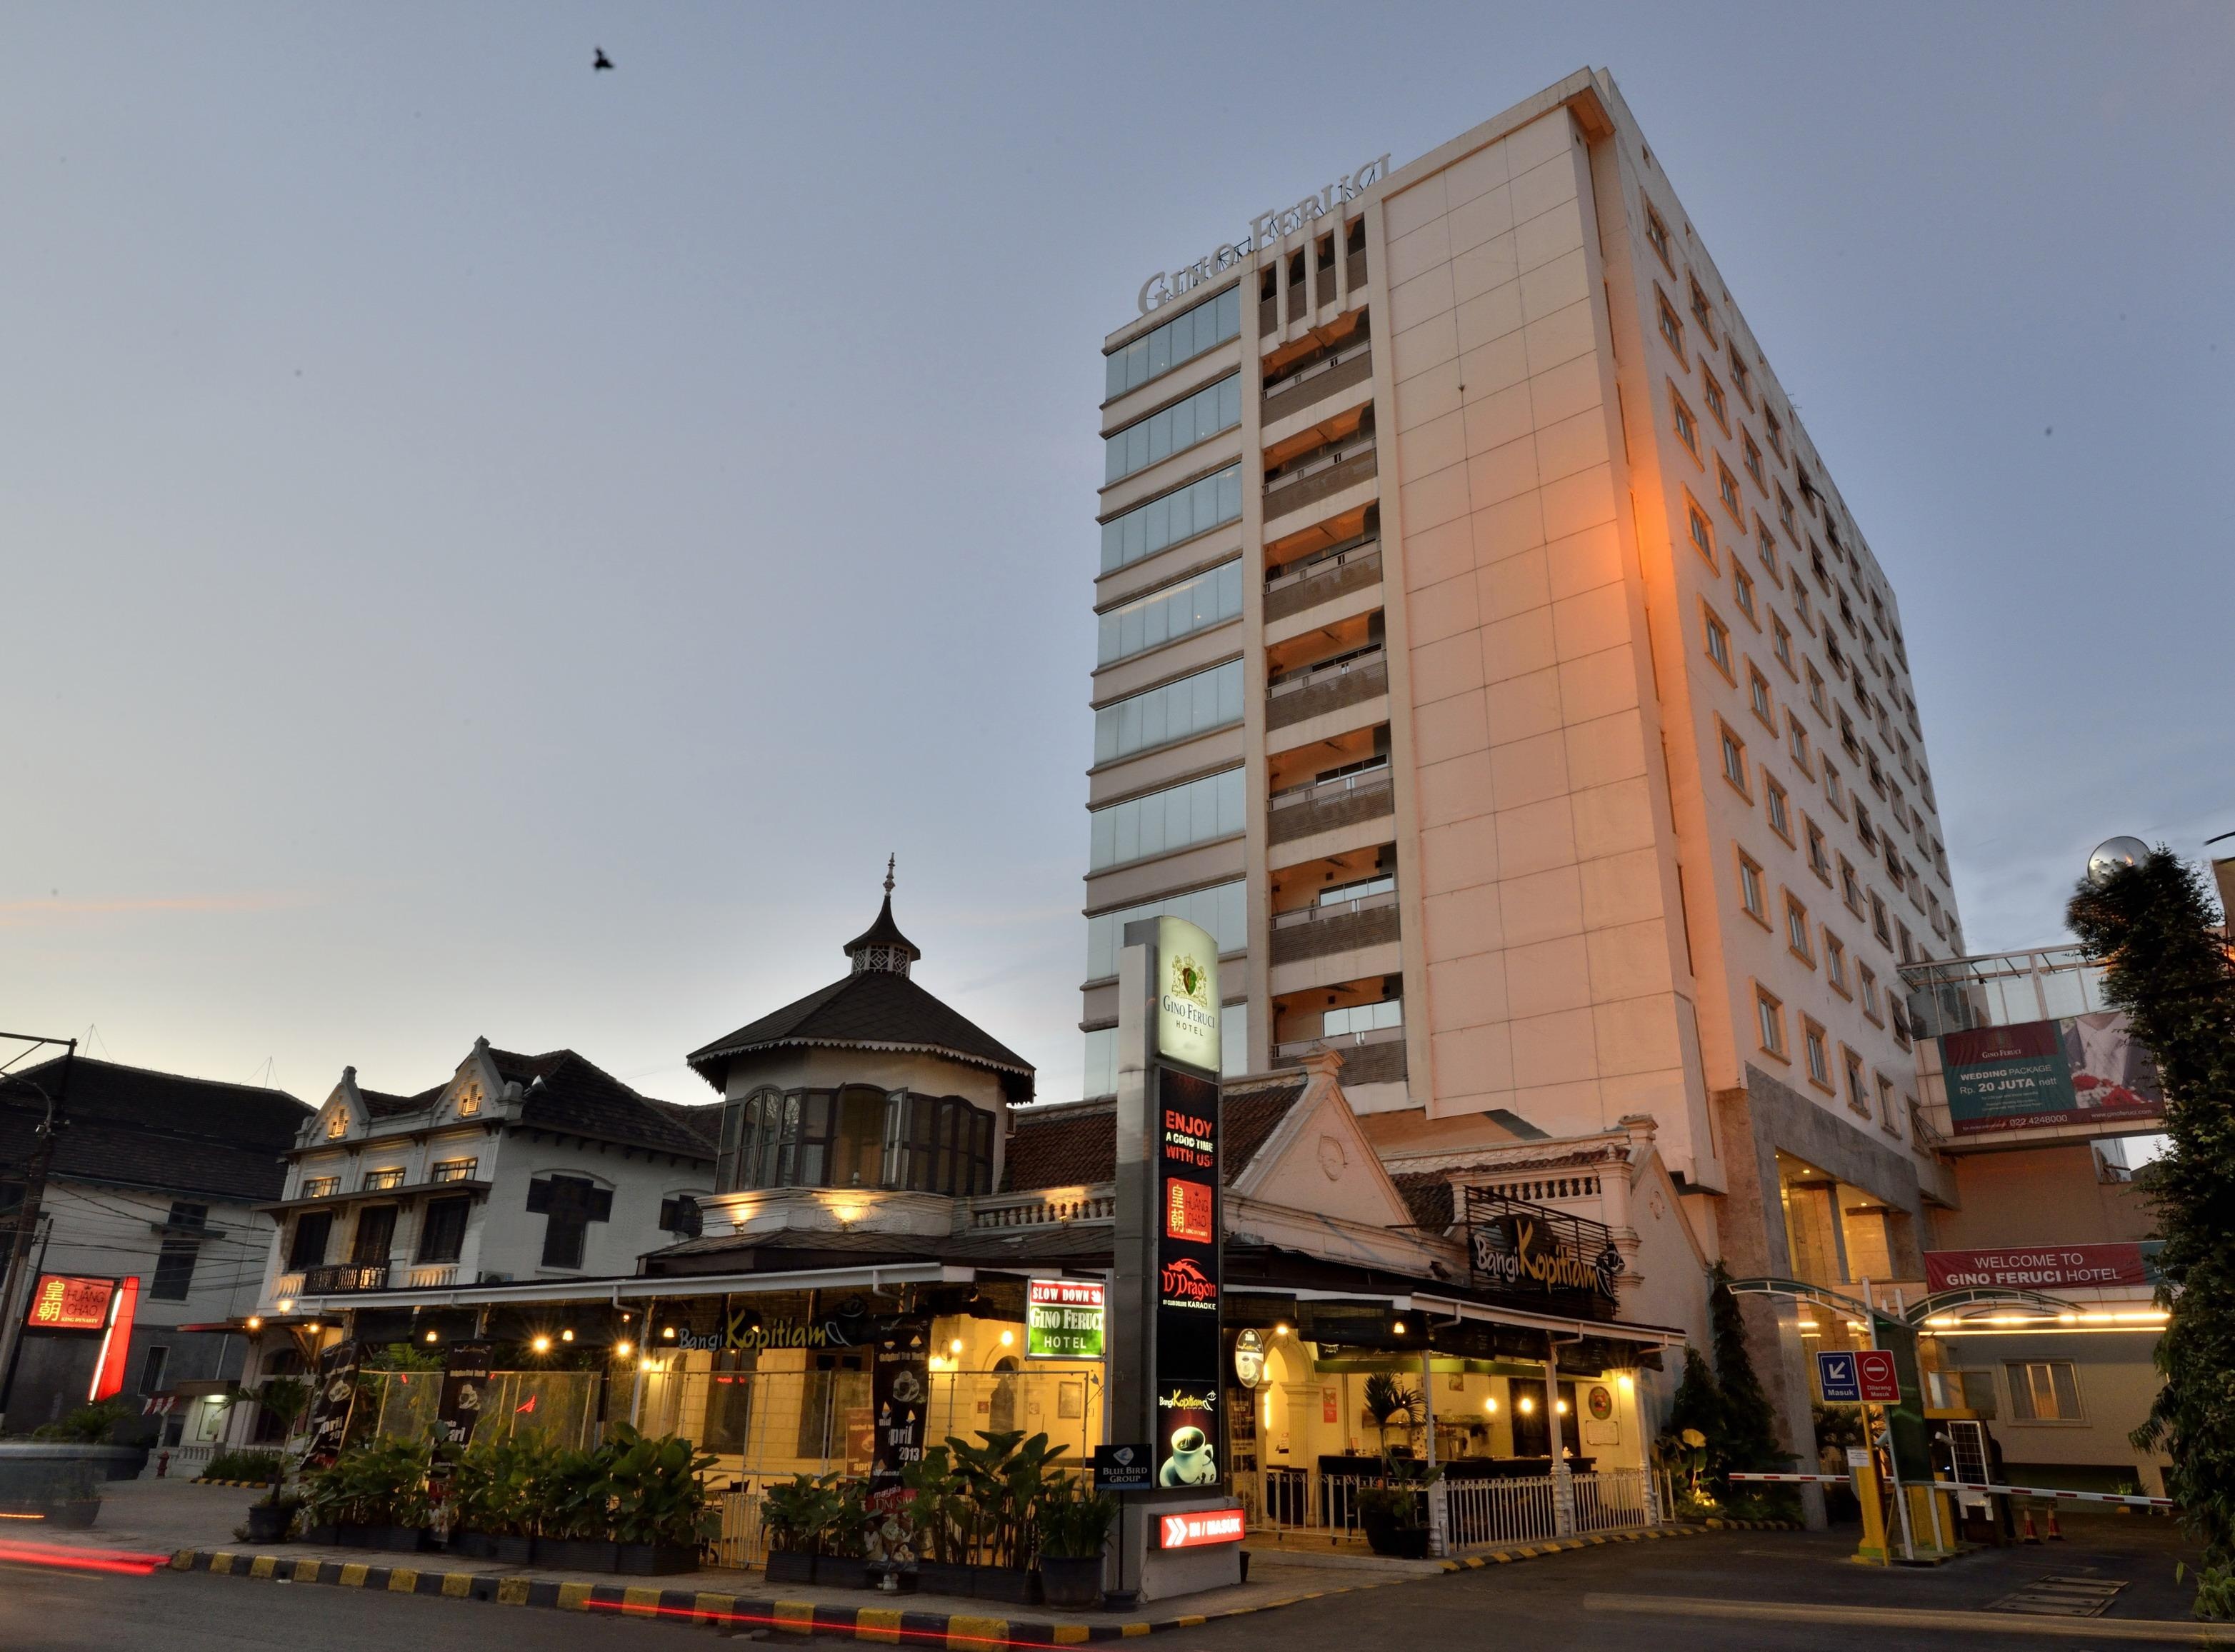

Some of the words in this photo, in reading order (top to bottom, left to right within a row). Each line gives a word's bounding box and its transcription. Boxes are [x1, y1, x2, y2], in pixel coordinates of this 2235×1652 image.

[1138, 243, 1236, 316] GINO
[1249, 152, 1391, 251] FERUCI
[1163, 995, 1186, 1017] GINO
[1188, 1003, 1215, 1029] FERUCI
[1176, 1021, 1204, 1036] HOTEL
[1999, 1048, 2021, 1057] FERUCI
[1960, 1069, 2007, 1081] WEDDING
[2009, 1064, 2052, 1075] PACKAGE
[1959, 1086, 1976, 1095] Rp.
[1978, 1082, 1995, 1093] 20
[1997, 1078, 2035, 1091] JUTA
[2039, 1077, 2057, 1086] nett
[1166, 1109, 1212, 1138] ENJOY
[2009, 1114, 2068, 1126] 022.4248000
[1166, 1131, 1171, 1141] A
[1173, 1133, 1195, 1147] GOOD
[1196, 1138, 1214, 1153] TIME
[1166, 1144, 1194, 1163] WITH
[1170, 1183, 1184, 1233] 皇朝
[1185, 1195, 1209, 1213] HUANG
[1187, 1212, 1206, 1228] CHAO
[1474, 1232, 1520, 1283] Bangi
[1516, 1218, 1598, 1294] Kopitiam
[1974, 1254, 2056, 1269] WELCOME
[2060, 1253, 2083, 1266] TO
[1161, 1269, 1216, 1301] D'Dragon
[1946, 1272, 1990, 1286] GINO
[1996, 1270, 2061, 1284] FERUCI
[2066, 1268, 2121, 1282] HOTEL
[37, 1281, 66, 1321] 皇朝
[66, 1289, 106, 1303] HUANG
[1033, 1286, 1059, 1300] SLOW
[1063, 1289, 1089, 1302] DOWN
[66, 1303, 98, 1316] CHAO
[1187, 1301, 1216, 1310] KARAOKE
[1029, 1307, 1061, 1329] GINO
[1063, 1309, 1103, 1331] FERUCI
[679, 1326, 724, 1351] Bangi
[725, 1309, 826, 1355] Kopitiam
[1044, 1336, 1086, 1349] HOTEL
[1159, 1396, 1174, 1408] Bangi
[1173, 1388, 1204, 1410] Kopitiam
[1828, 1388, 1854, 1397] Masuk
[899, 1447, 920, 1461] 2013
[1103, 1467, 1124, 1476] BLUE
[1189, 1522, 1200, 1537] IN
[1207, 1518, 1240, 1536] MASUK
